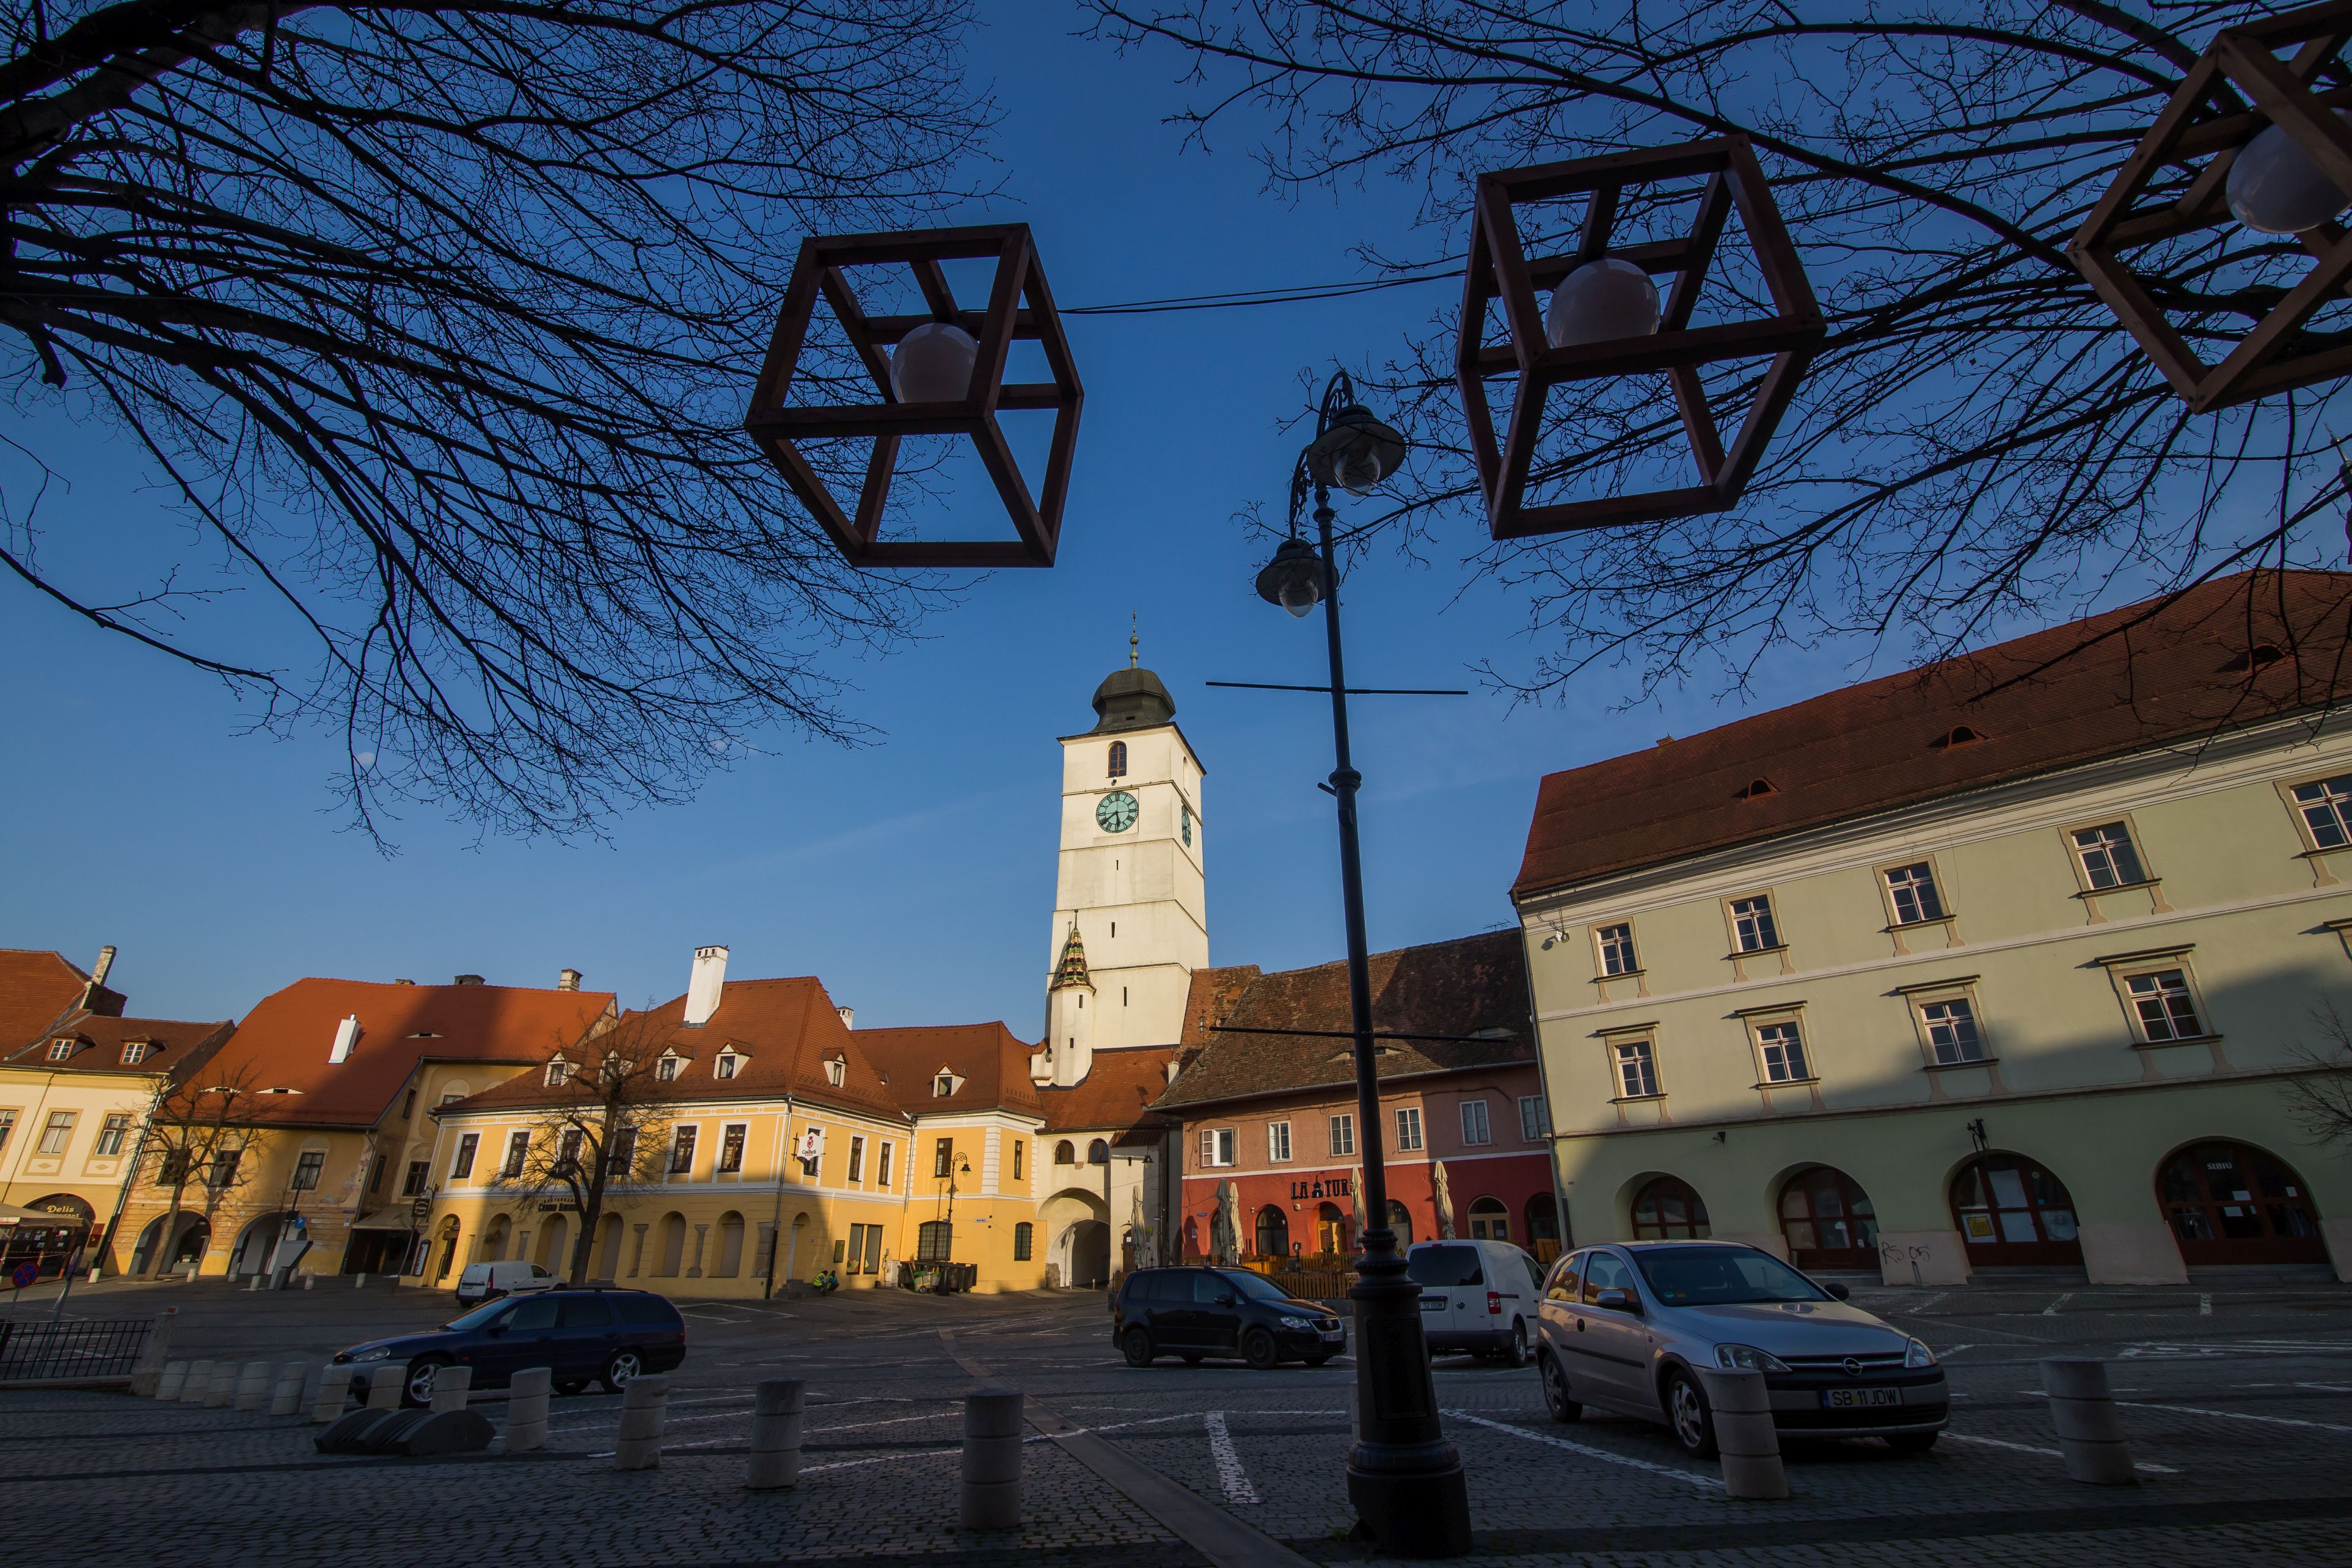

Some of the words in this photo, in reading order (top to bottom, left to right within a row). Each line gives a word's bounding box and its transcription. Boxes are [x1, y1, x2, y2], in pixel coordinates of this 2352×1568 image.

[1291, 1182, 1309, 1200] LA
[1324, 1179, 1352, 1197] TUR
[1833, 1391, 1853, 1406] SB
[1857, 1390, 1868, 1405] 11
[1871, 1390, 1896, 1405] JDW
